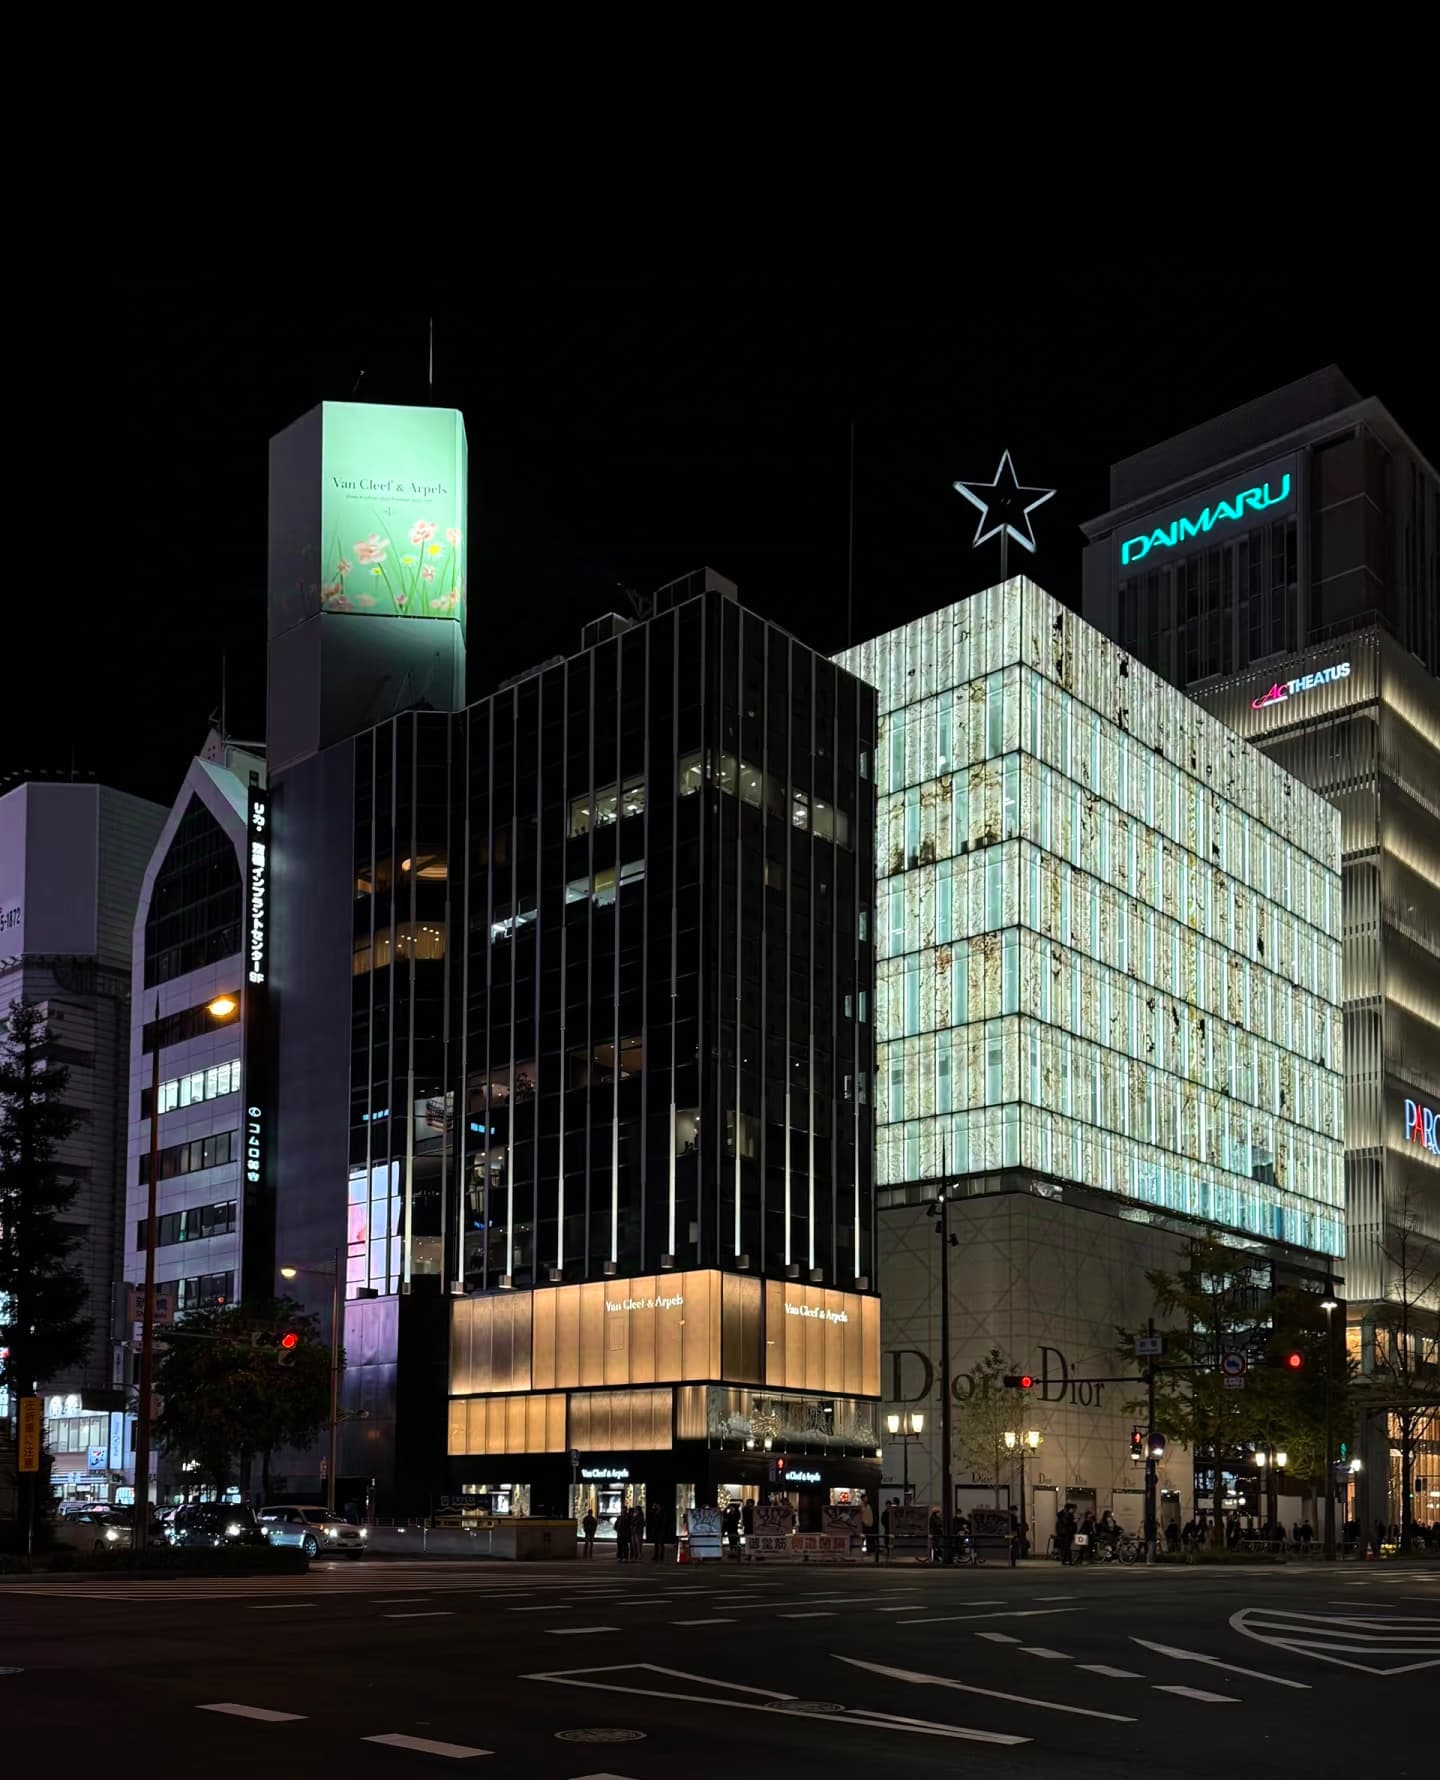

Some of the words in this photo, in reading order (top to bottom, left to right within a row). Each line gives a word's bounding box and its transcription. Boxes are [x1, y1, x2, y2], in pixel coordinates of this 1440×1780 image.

[333, 476, 356, 489] Van
[359, 479, 393, 492] Cleef
[395, 483, 404, 492] &
[409, 481, 448, 497] Arpels
[1121, 473, 1292, 565] DAIMARU
[605, 1300, 622, 1312] Van
[623, 1297, 645, 1310] Cleef
[655, 1292, 684, 1310] Arpels
[785, 1302, 799, 1315] Van
[1036, 1345, 1105, 1408] Dior
